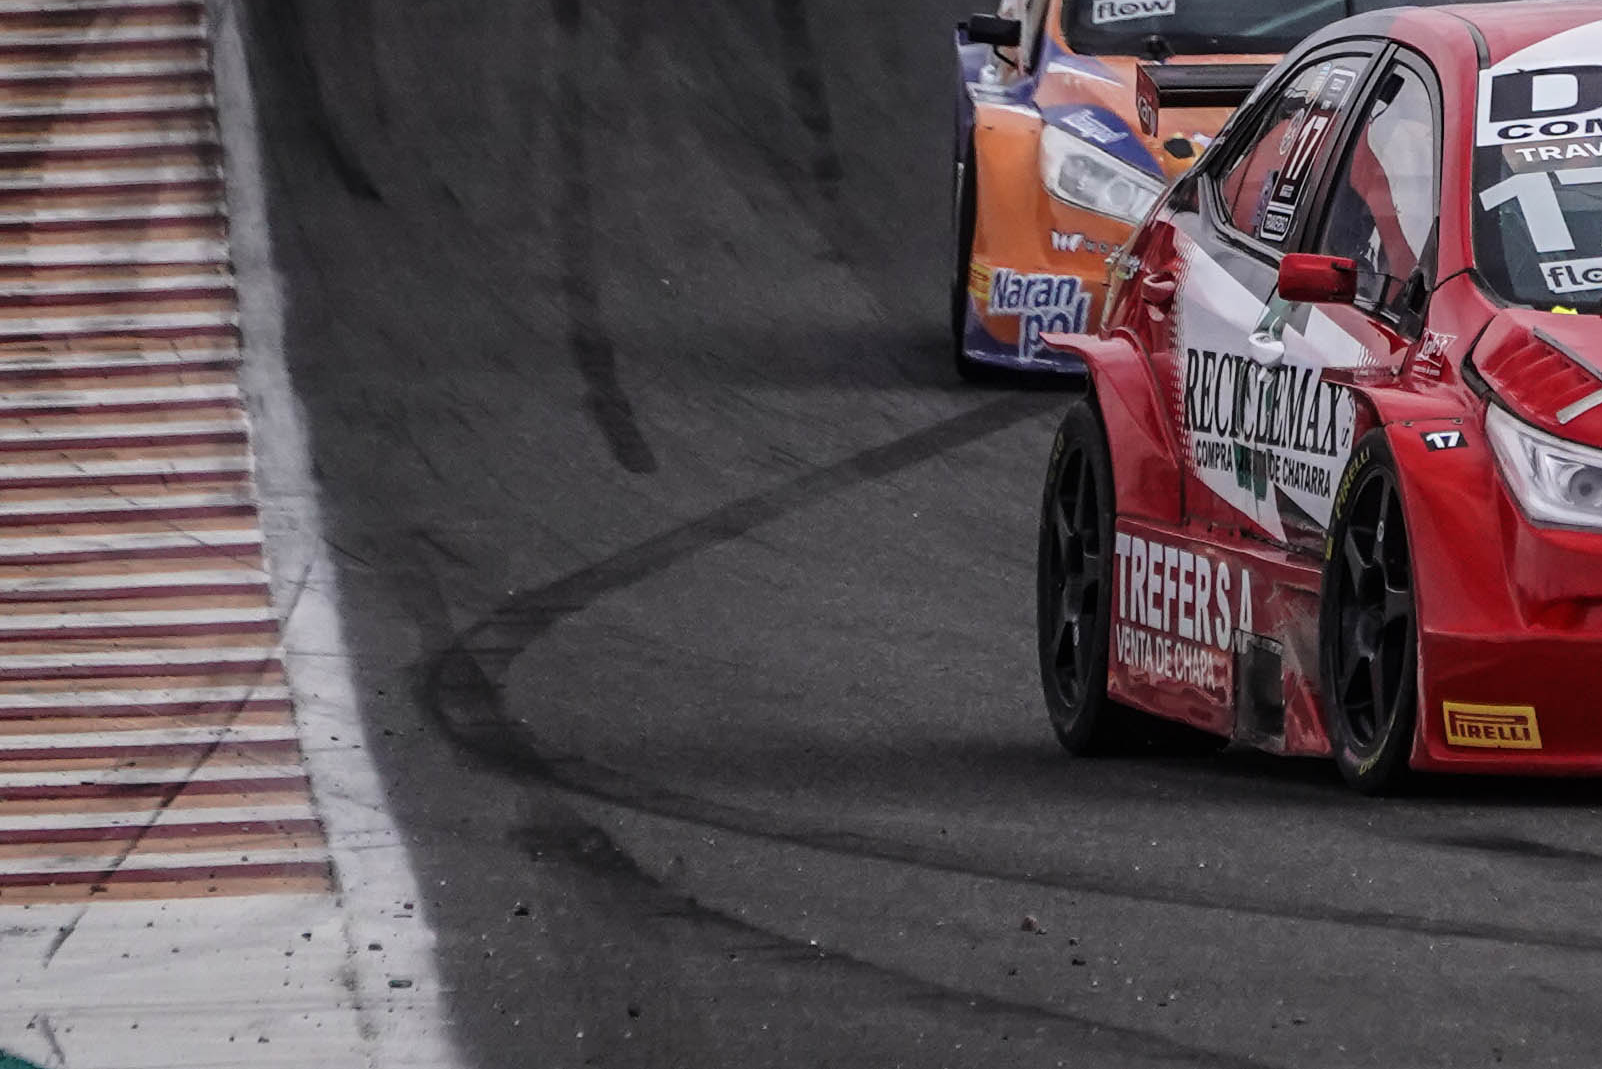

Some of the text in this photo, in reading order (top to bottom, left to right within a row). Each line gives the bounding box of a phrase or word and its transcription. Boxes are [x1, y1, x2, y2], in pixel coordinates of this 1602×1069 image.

[1098, 0, 1172, 19] flow
[992, 270, 1080, 310] Naran
[1425, 431, 1460, 448] 17
[1195, 439, 1232, 473] COMPRA
[1282, 457, 1331, 499] CHATARRA
[1116, 623, 1153, 672] VENTA
[1448, 710, 1532, 741] PIRELLI
